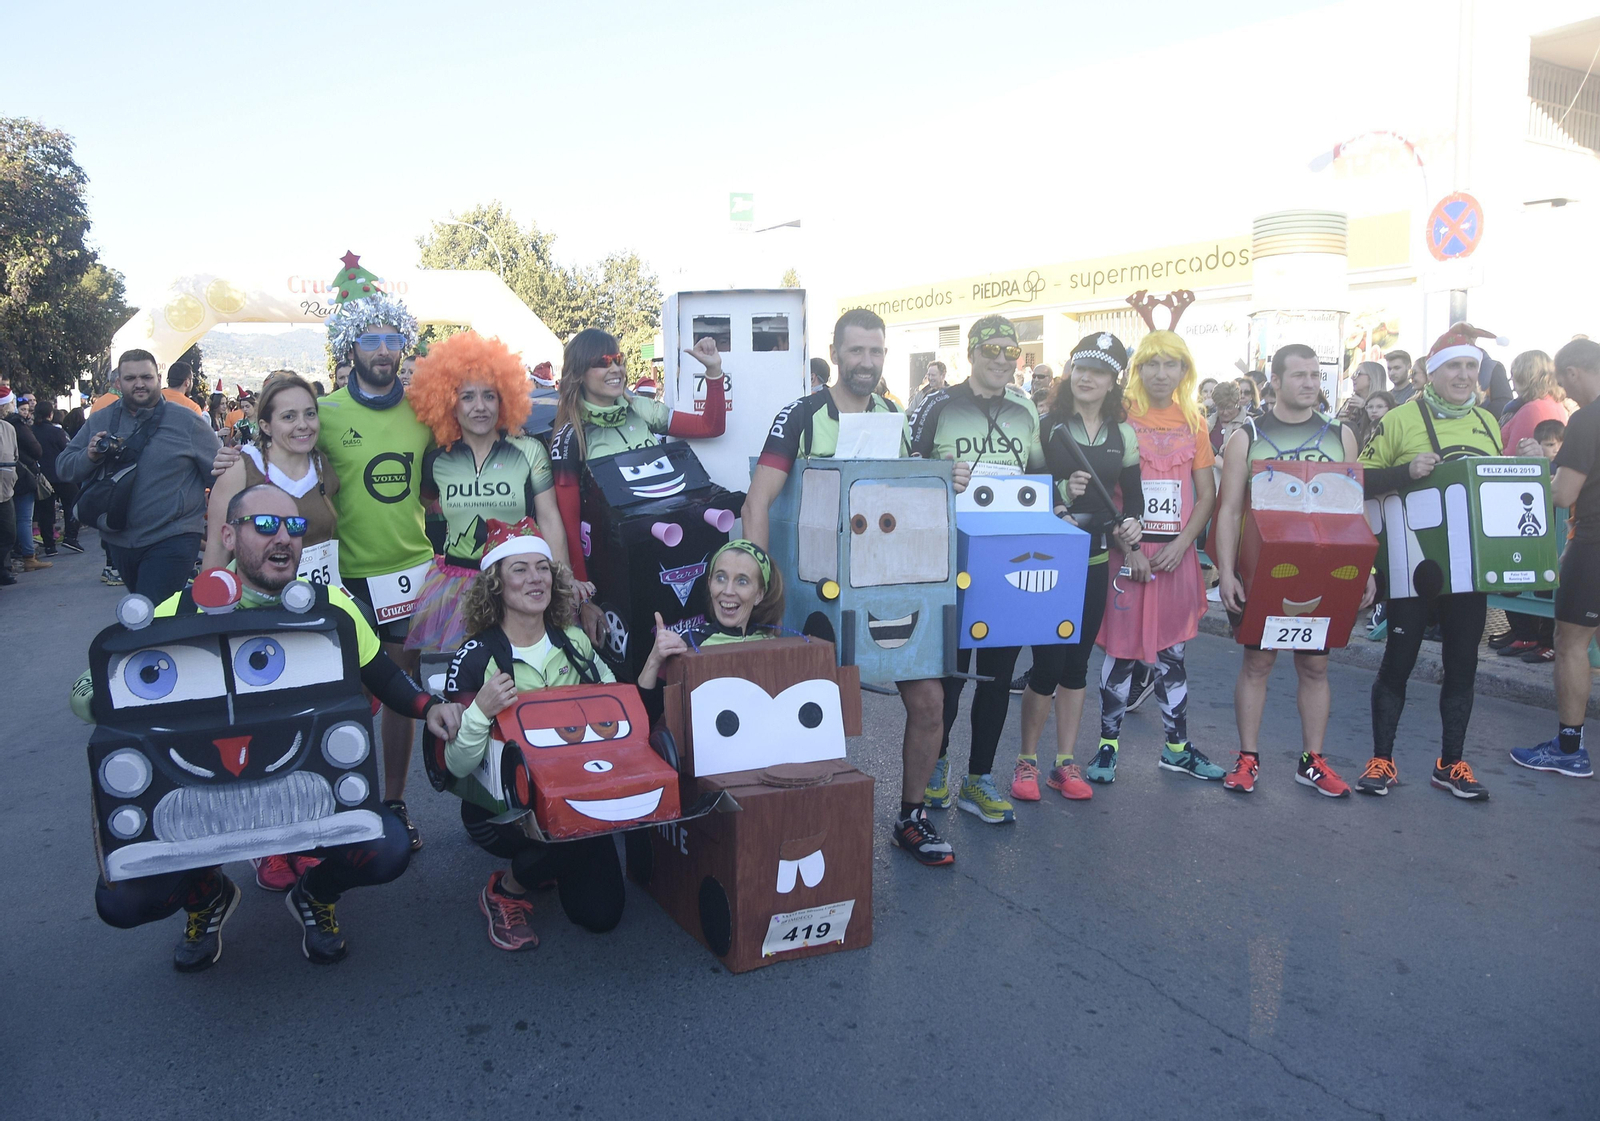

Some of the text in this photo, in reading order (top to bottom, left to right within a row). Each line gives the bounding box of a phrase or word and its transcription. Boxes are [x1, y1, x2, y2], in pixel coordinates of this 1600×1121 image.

[1069, 244, 1250, 295] supermercados
[694, 374, 732, 392] 73
[956, 437, 1023, 459] pulso
[371, 474, 407, 483] VOLVO
[1503, 466, 1518, 474] AÑO
[446, 501, 462, 509] TRAIL
[498, 500, 517, 508] CLUB
[1147, 497, 1178, 515] 845
[664, 569, 701, 581] Cars
[397, 575, 412, 594] 9
[1276, 627, 1313, 643] 278
[590, 762, 604, 771] 1
[782, 921, 831, 942] 419
